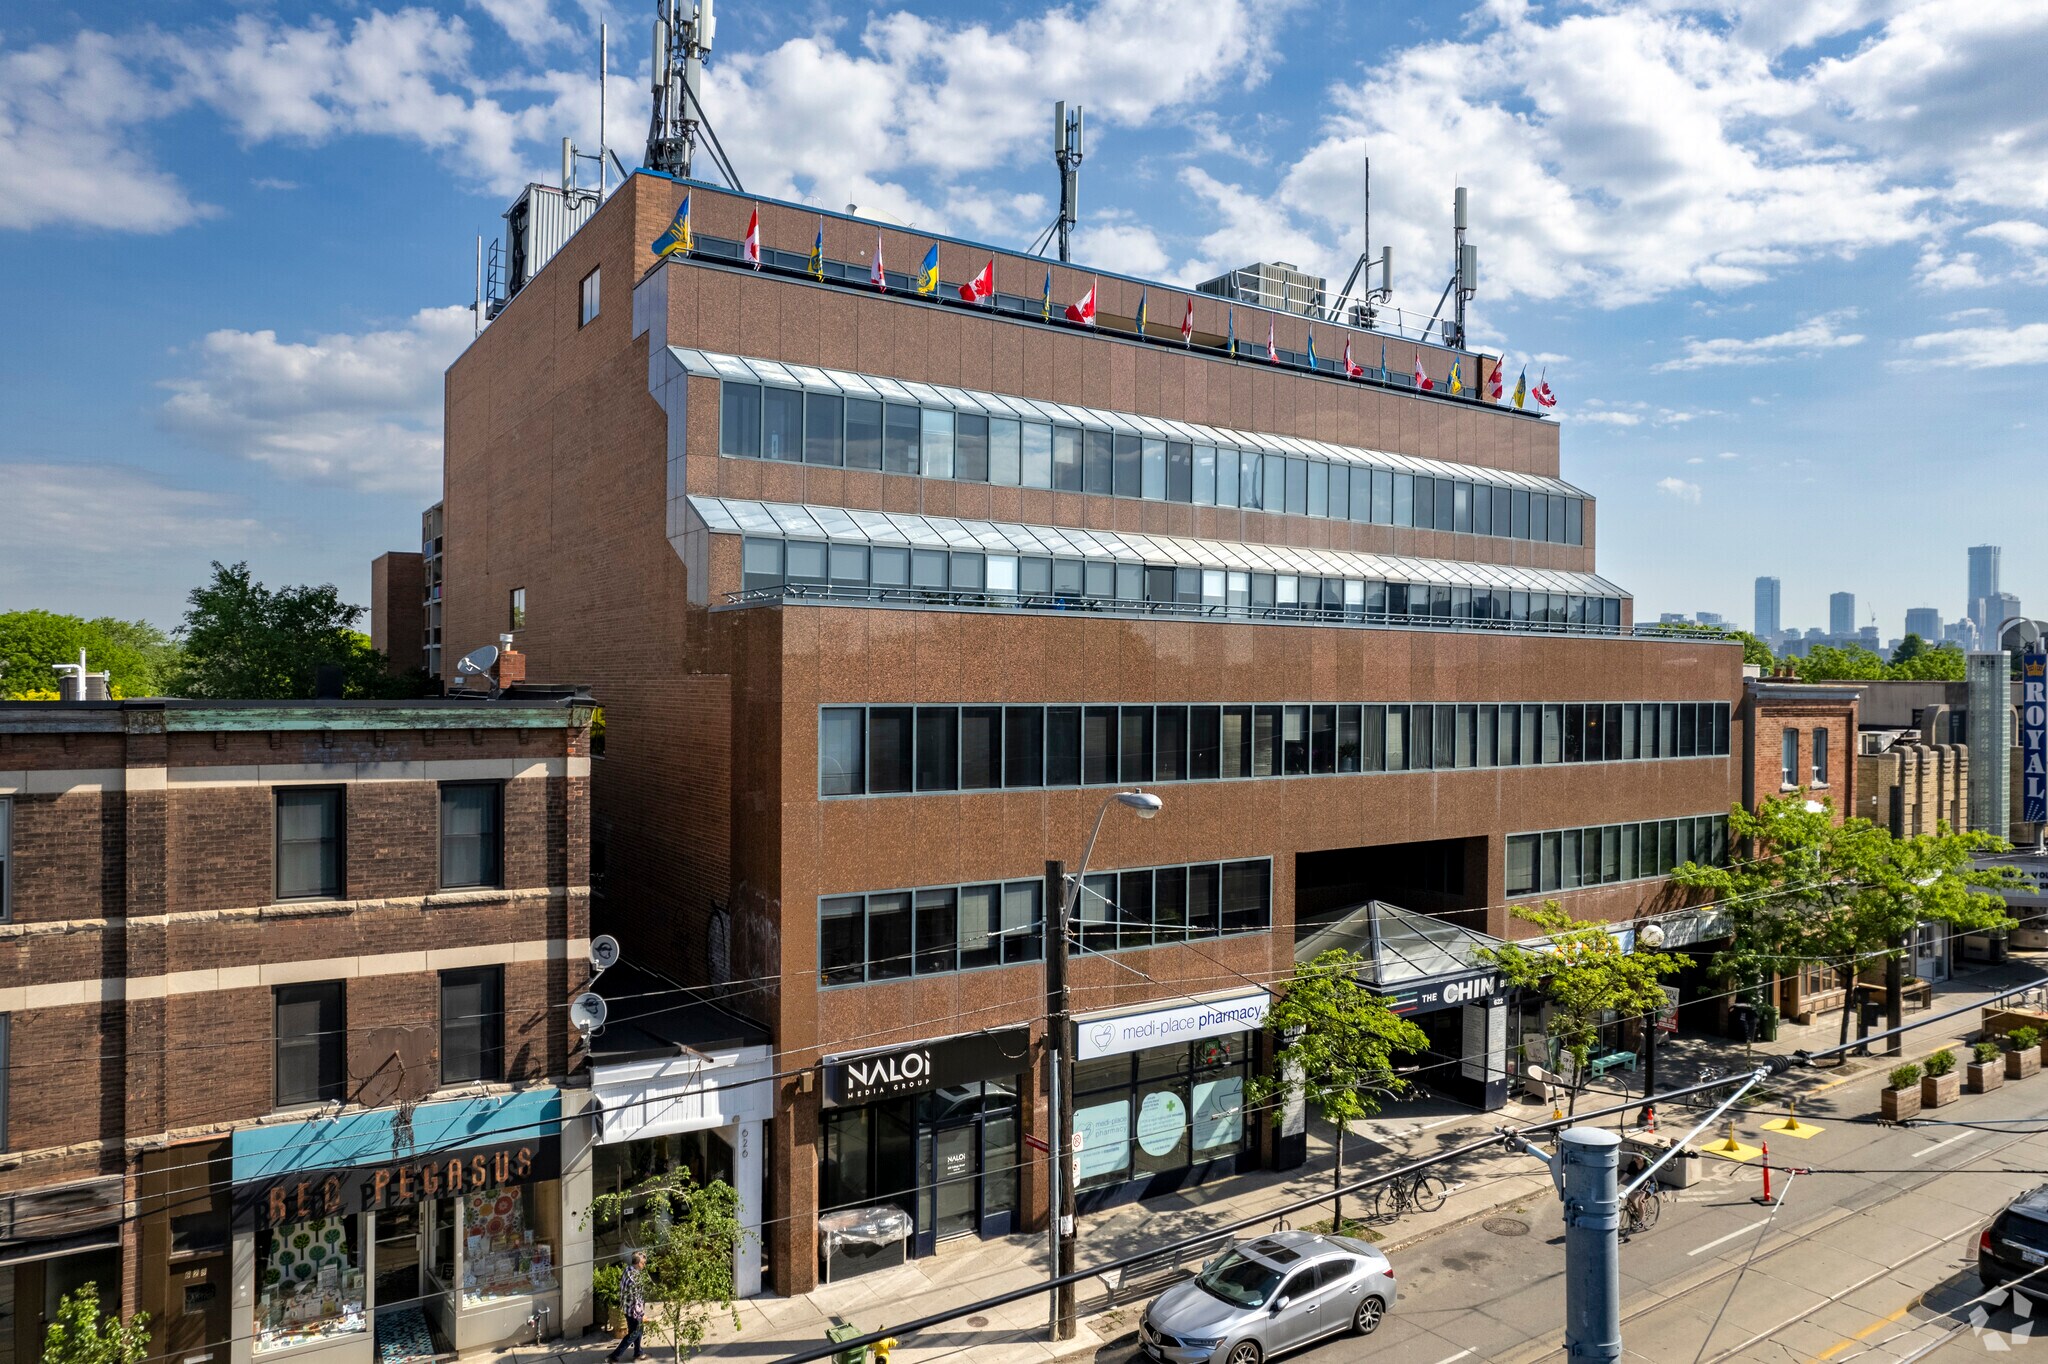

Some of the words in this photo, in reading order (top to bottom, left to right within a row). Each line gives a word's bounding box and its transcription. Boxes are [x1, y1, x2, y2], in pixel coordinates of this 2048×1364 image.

[2025, 681, 2046, 799] ROYAL
[1422, 992, 1437, 1003] THE
[1443, 976, 1495, 1004] CHIN
[1123, 1016, 1195, 1040] medi-place
[1199, 1004, 1262, 1031] pharmacy
[1283, 1024, 1307, 1037] CHIN
[847, 1087, 884, 1099] MEDIA
[893, 1078, 930, 1091] GROUP
[1095, 1126, 1127, 1138] pharmacy
[269, 1174, 342, 1224] RED
[374, 1147, 532, 1206] PEGASUS
